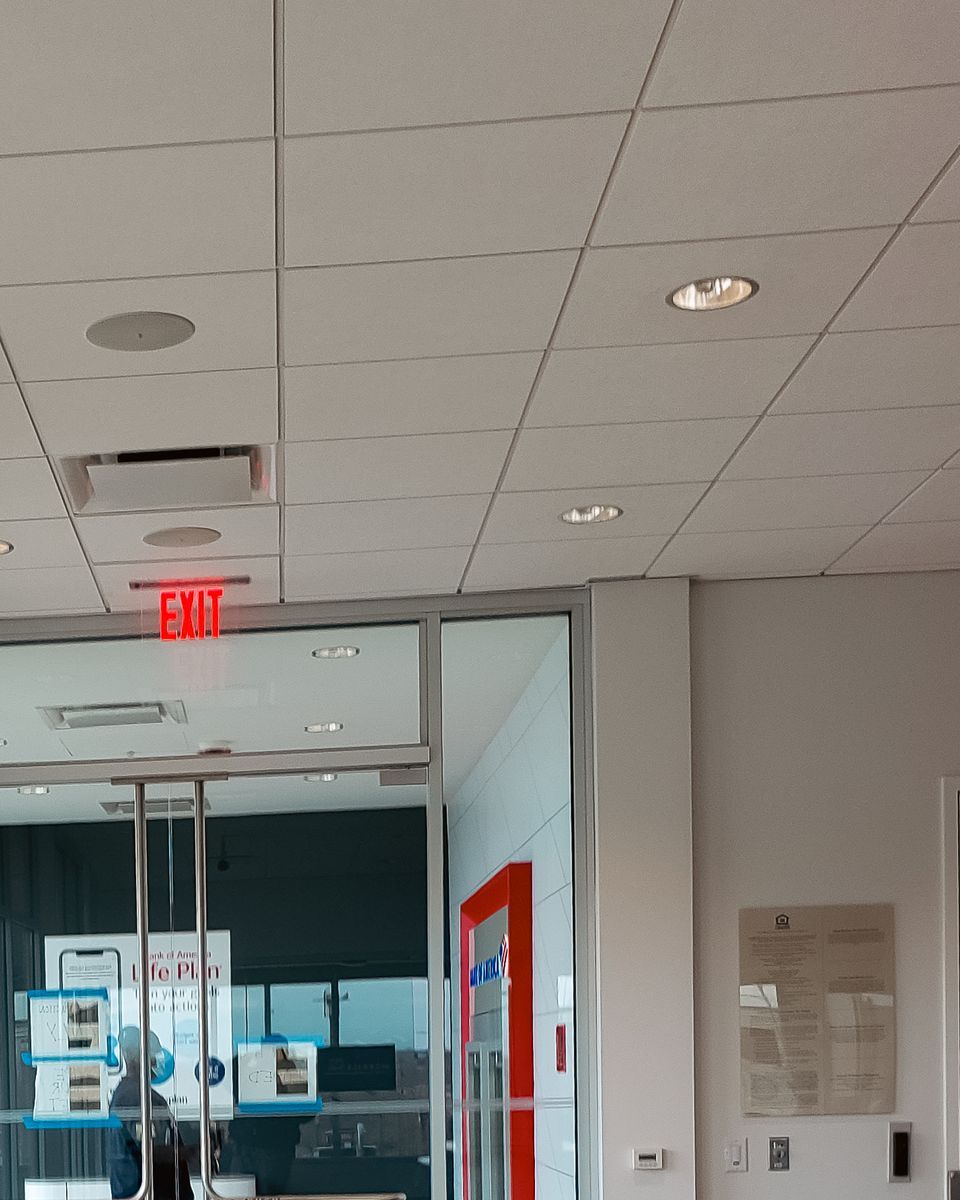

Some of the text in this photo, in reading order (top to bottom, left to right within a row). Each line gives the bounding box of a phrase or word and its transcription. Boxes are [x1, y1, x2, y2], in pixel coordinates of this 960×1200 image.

[159, 587, 224, 641] EXIT
[132, 961, 220, 982] Lfe Pln
